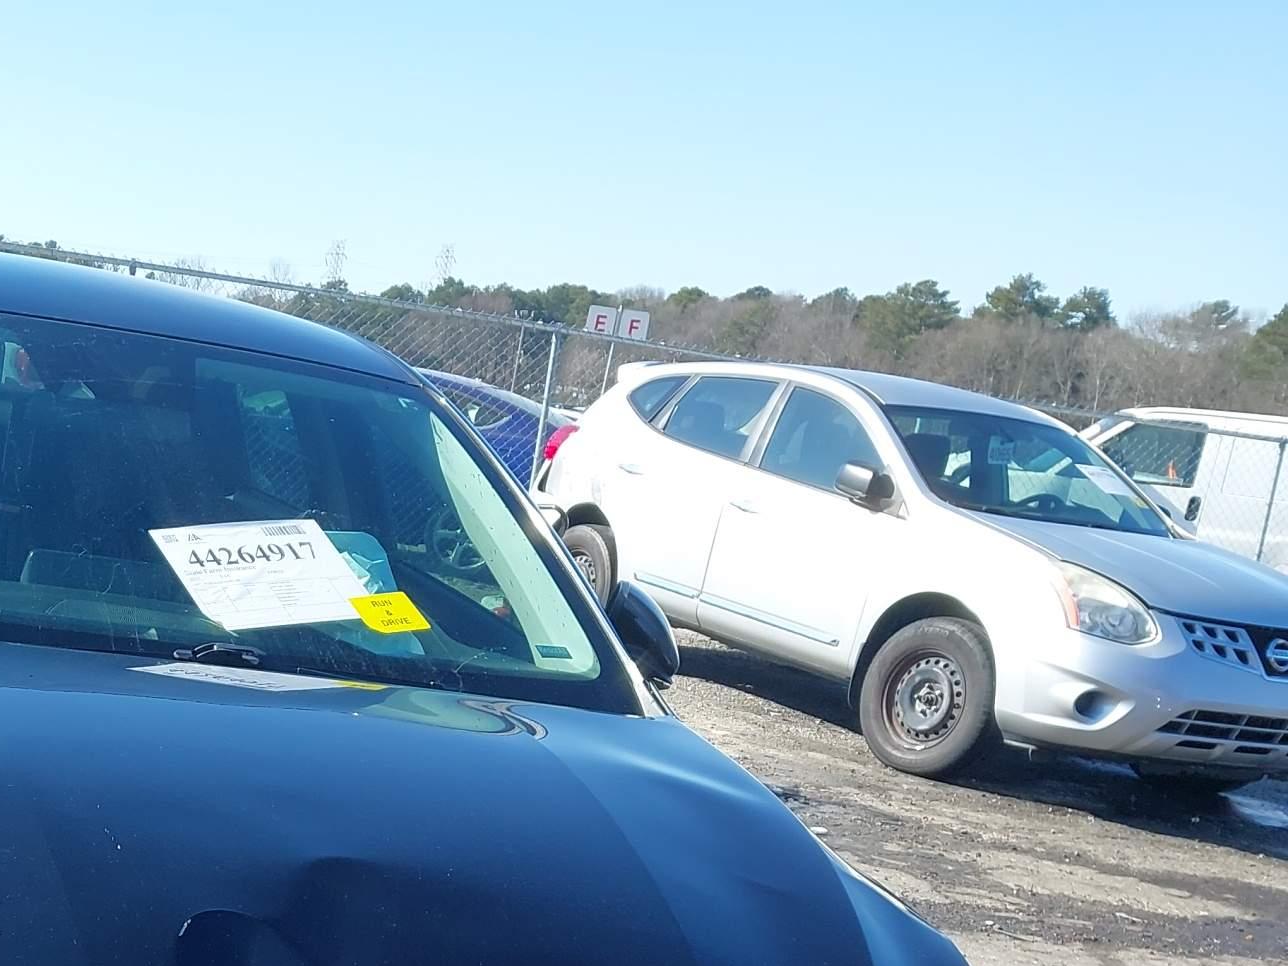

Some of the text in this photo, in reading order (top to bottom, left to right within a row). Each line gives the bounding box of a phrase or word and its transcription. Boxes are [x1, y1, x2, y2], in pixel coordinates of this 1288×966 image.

[594, 314, 608, 332] E
[629, 319, 642, 336] F
[188, 541, 316, 568] 44264917
[371, 599, 393, 608] RUN
[380, 616, 412, 627] DRIVE
